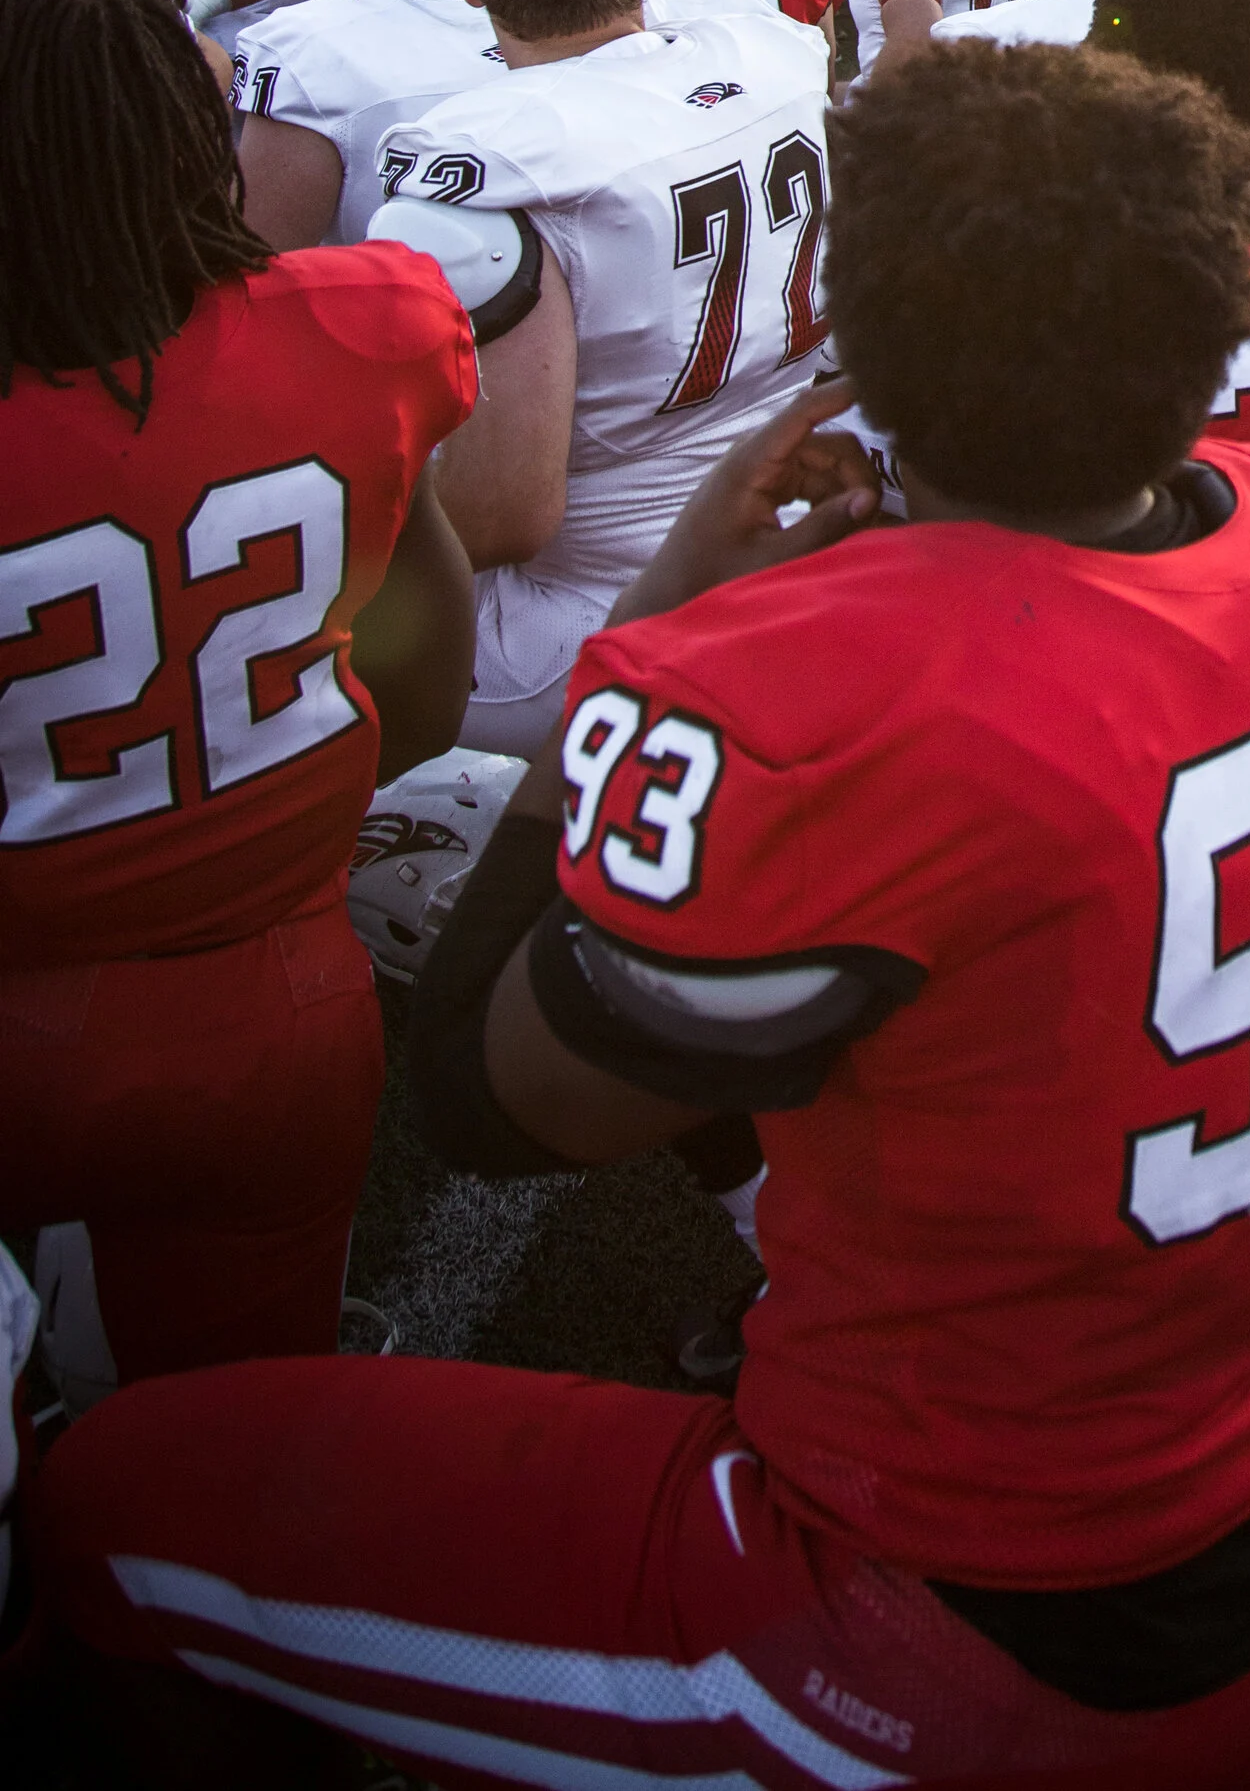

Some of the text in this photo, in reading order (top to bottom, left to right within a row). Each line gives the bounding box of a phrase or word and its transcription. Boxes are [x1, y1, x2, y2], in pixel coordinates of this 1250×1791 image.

[379, 147, 487, 206] 72
[655, 128, 827, 416] 72
[0, 453, 368, 848] 22
[556, 683, 725, 905] 93
[803, 1668, 915, 1753] RAIDERS
